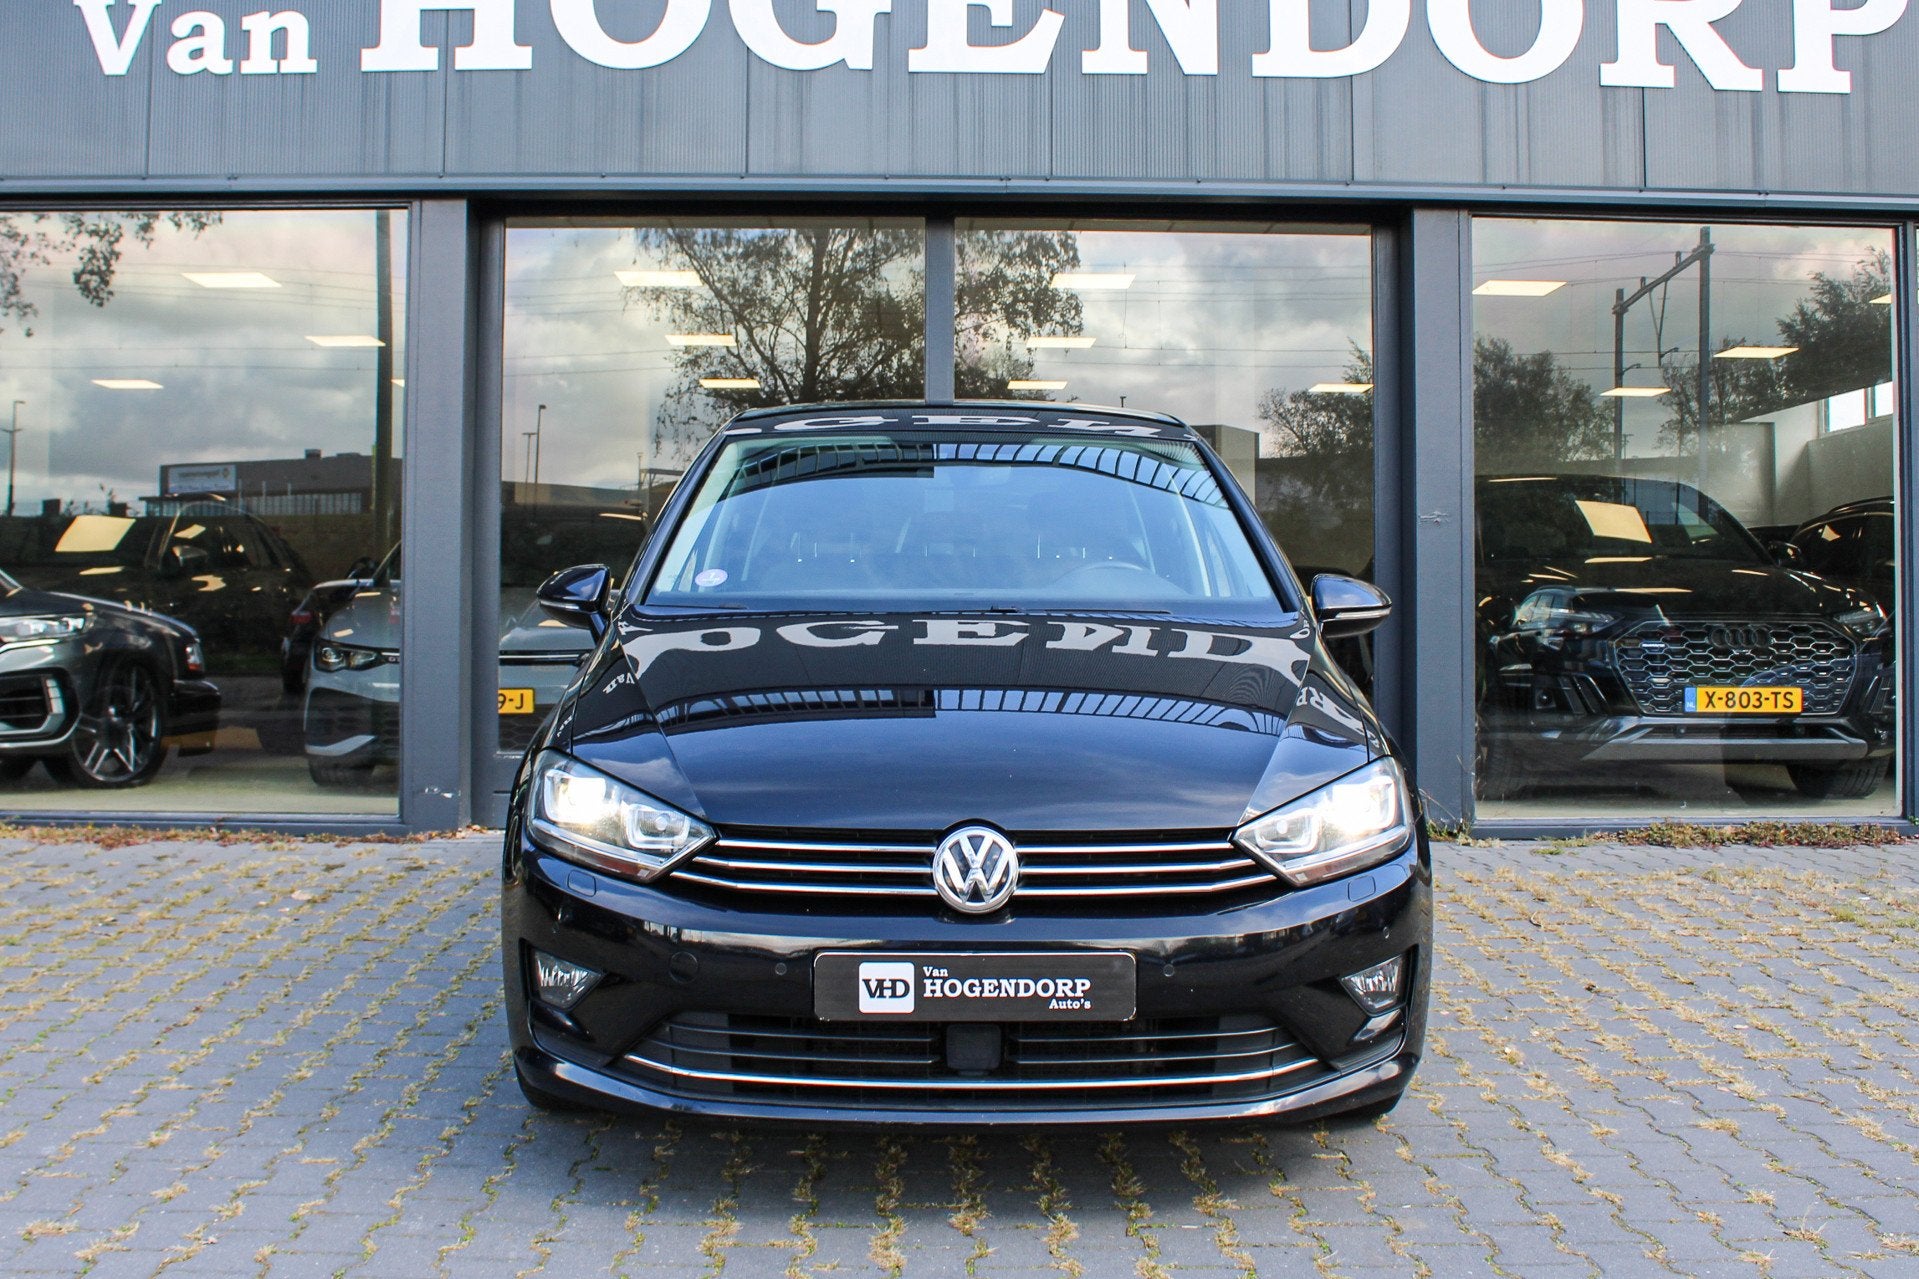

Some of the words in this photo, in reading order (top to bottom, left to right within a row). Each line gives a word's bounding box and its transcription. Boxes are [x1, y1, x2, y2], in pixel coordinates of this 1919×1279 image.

[73, 0, 318, 76] Van
[1704, 690, 1794, 709] X-803-TS
[923, 966, 949, 977] Van
[862, 978, 911, 999] VHD
[923, 978, 1092, 998] HOGENDORP
[1049, 998, 1092, 1010] Auto's
